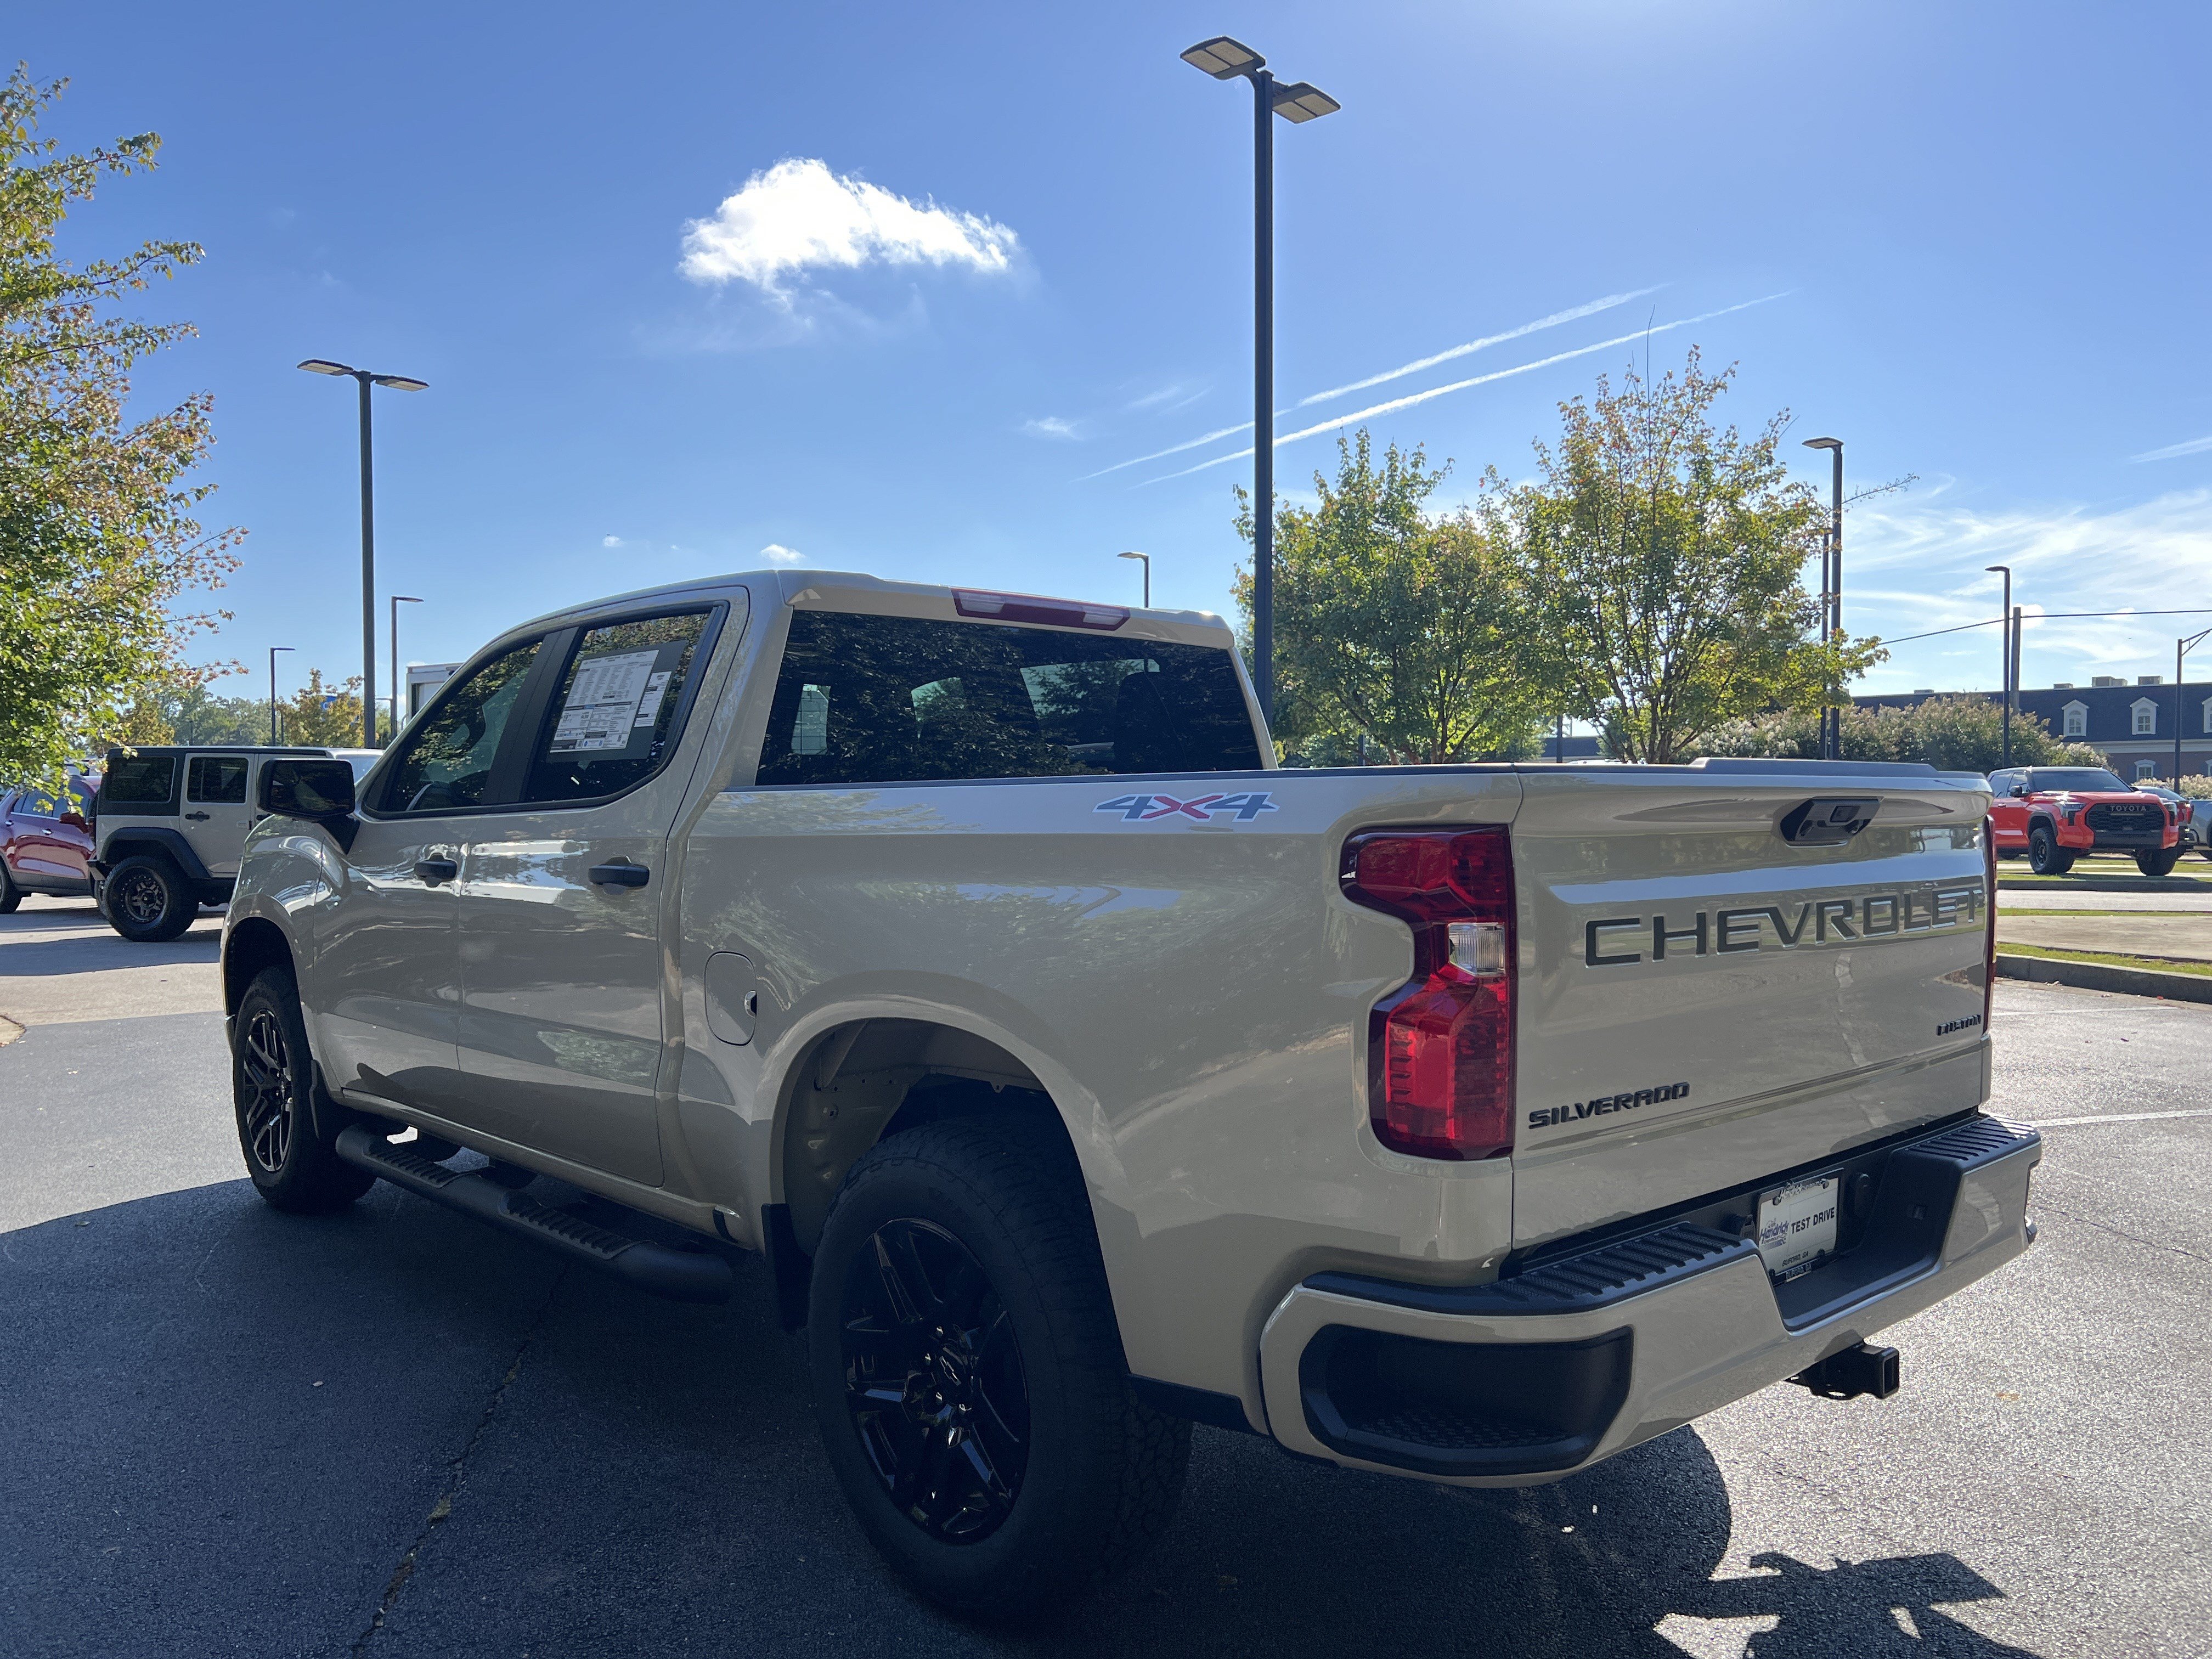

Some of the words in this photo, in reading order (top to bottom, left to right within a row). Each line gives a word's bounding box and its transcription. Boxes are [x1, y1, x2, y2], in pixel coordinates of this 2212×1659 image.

[1584, 889, 1983, 969] CHEVROLET
[1528, 1081, 1690, 1130] SILVERADO
[1759, 1220, 1790, 1244] Hendrick
[1791, 1216, 1810, 1234] TEST
[1813, 1206, 1835, 1226] DRIVE
